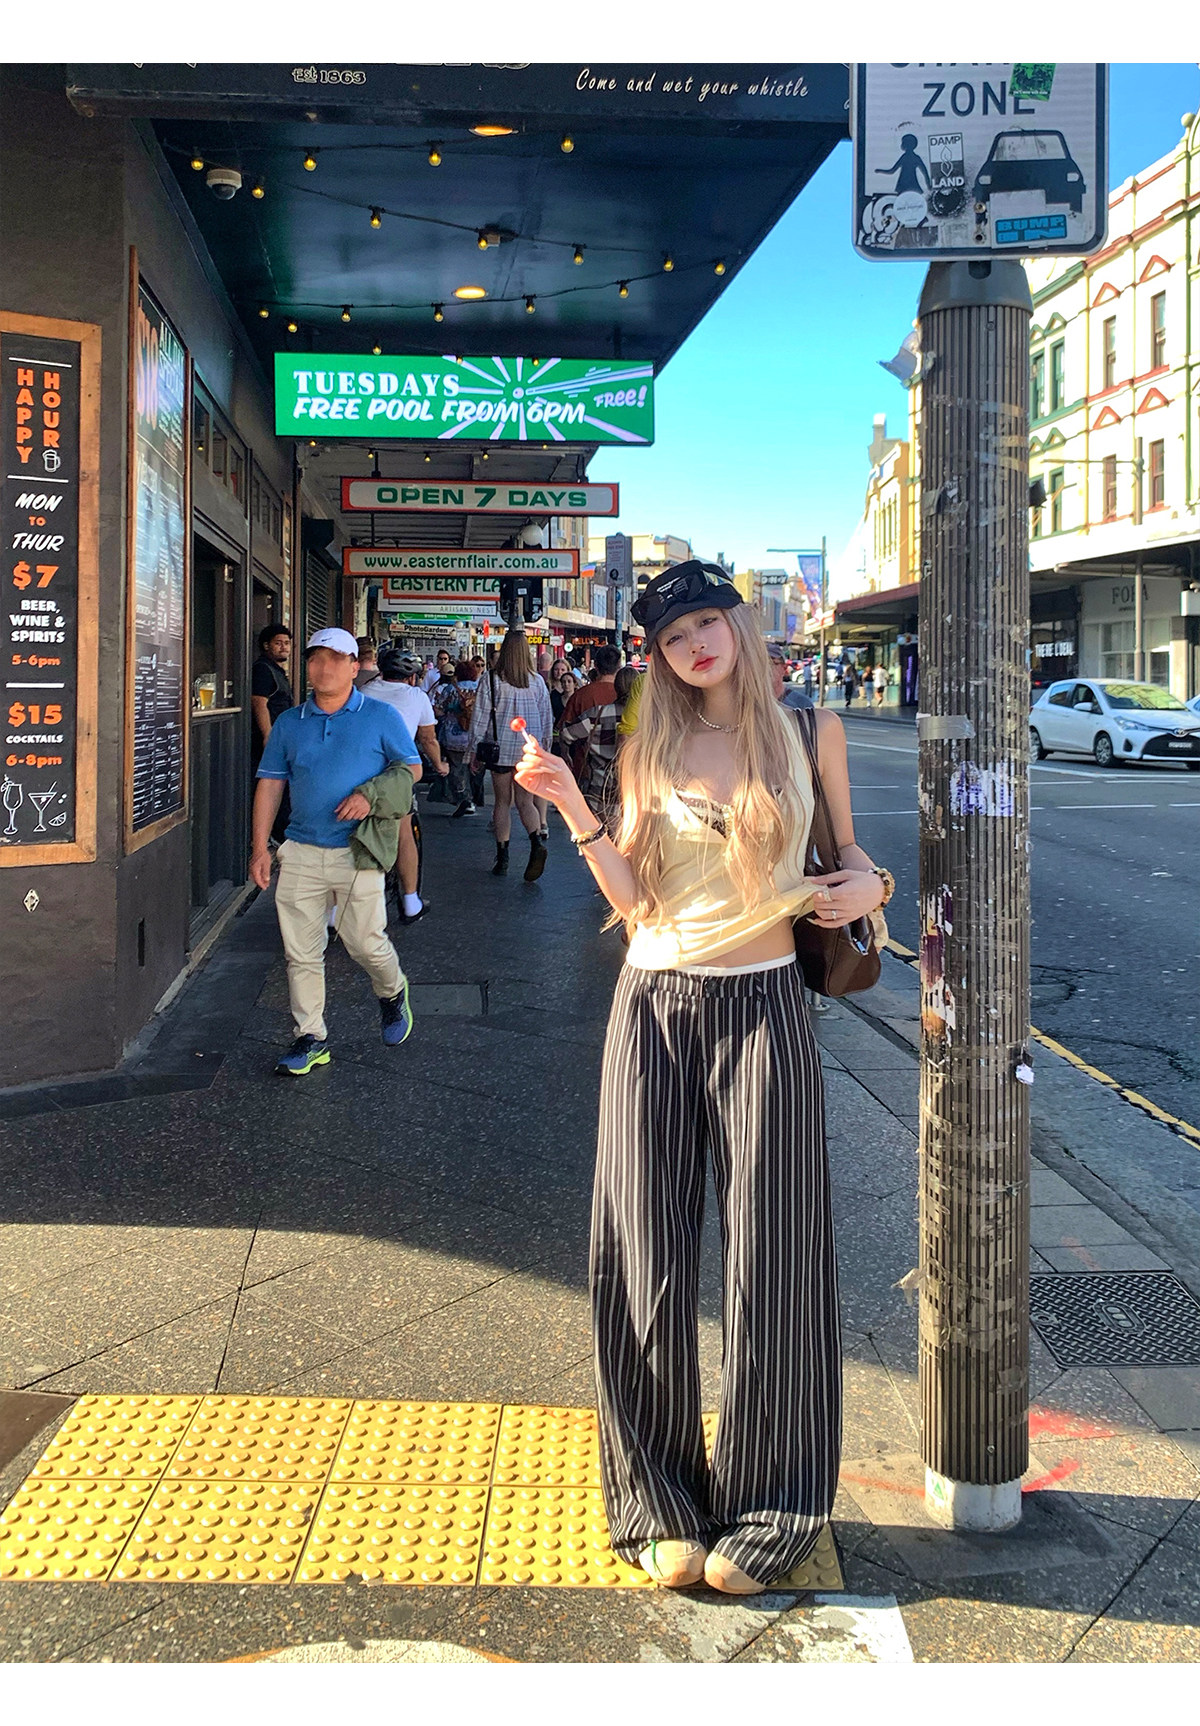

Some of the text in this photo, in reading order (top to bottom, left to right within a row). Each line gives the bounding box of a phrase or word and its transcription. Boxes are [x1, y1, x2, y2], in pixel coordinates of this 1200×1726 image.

[320, 70, 366, 84] 1863
[576, 68, 809, 102] Come and wet your whistle
[930, 136, 961, 147] DAMP
[932, 177, 965, 188] LAND
[293, 370, 460, 397] TUESDAYS
[16, 368, 34, 463] HAPPY
[42, 371, 61, 448] HOUR
[293, 397, 586, 424] FREE POOL FROM 6PM
[15, 493, 63, 512] MON
[377, 487, 587, 507] OPEN 7 DAYS
[28, 515, 46, 527] TO
[12, 532, 65, 552] THUR
[364, 554, 558, 569] www.easternflair.com.au
[391, 577, 500, 593] EASTERN FLA
[21, 599, 61, 614] BEER,
[477, 606, 495, 614] NEST
[9, 614, 66, 628] WINE &
[11, 630, 66, 643] SPIRITS
[404, 626, 448, 634] PhotoGarden
[12, 654, 61, 669] 5-6pm
[8, 701, 63, 728] $15
[5, 734, 64, 744] COCKTAILS
[6, 753, 63, 769] 6-8pm
